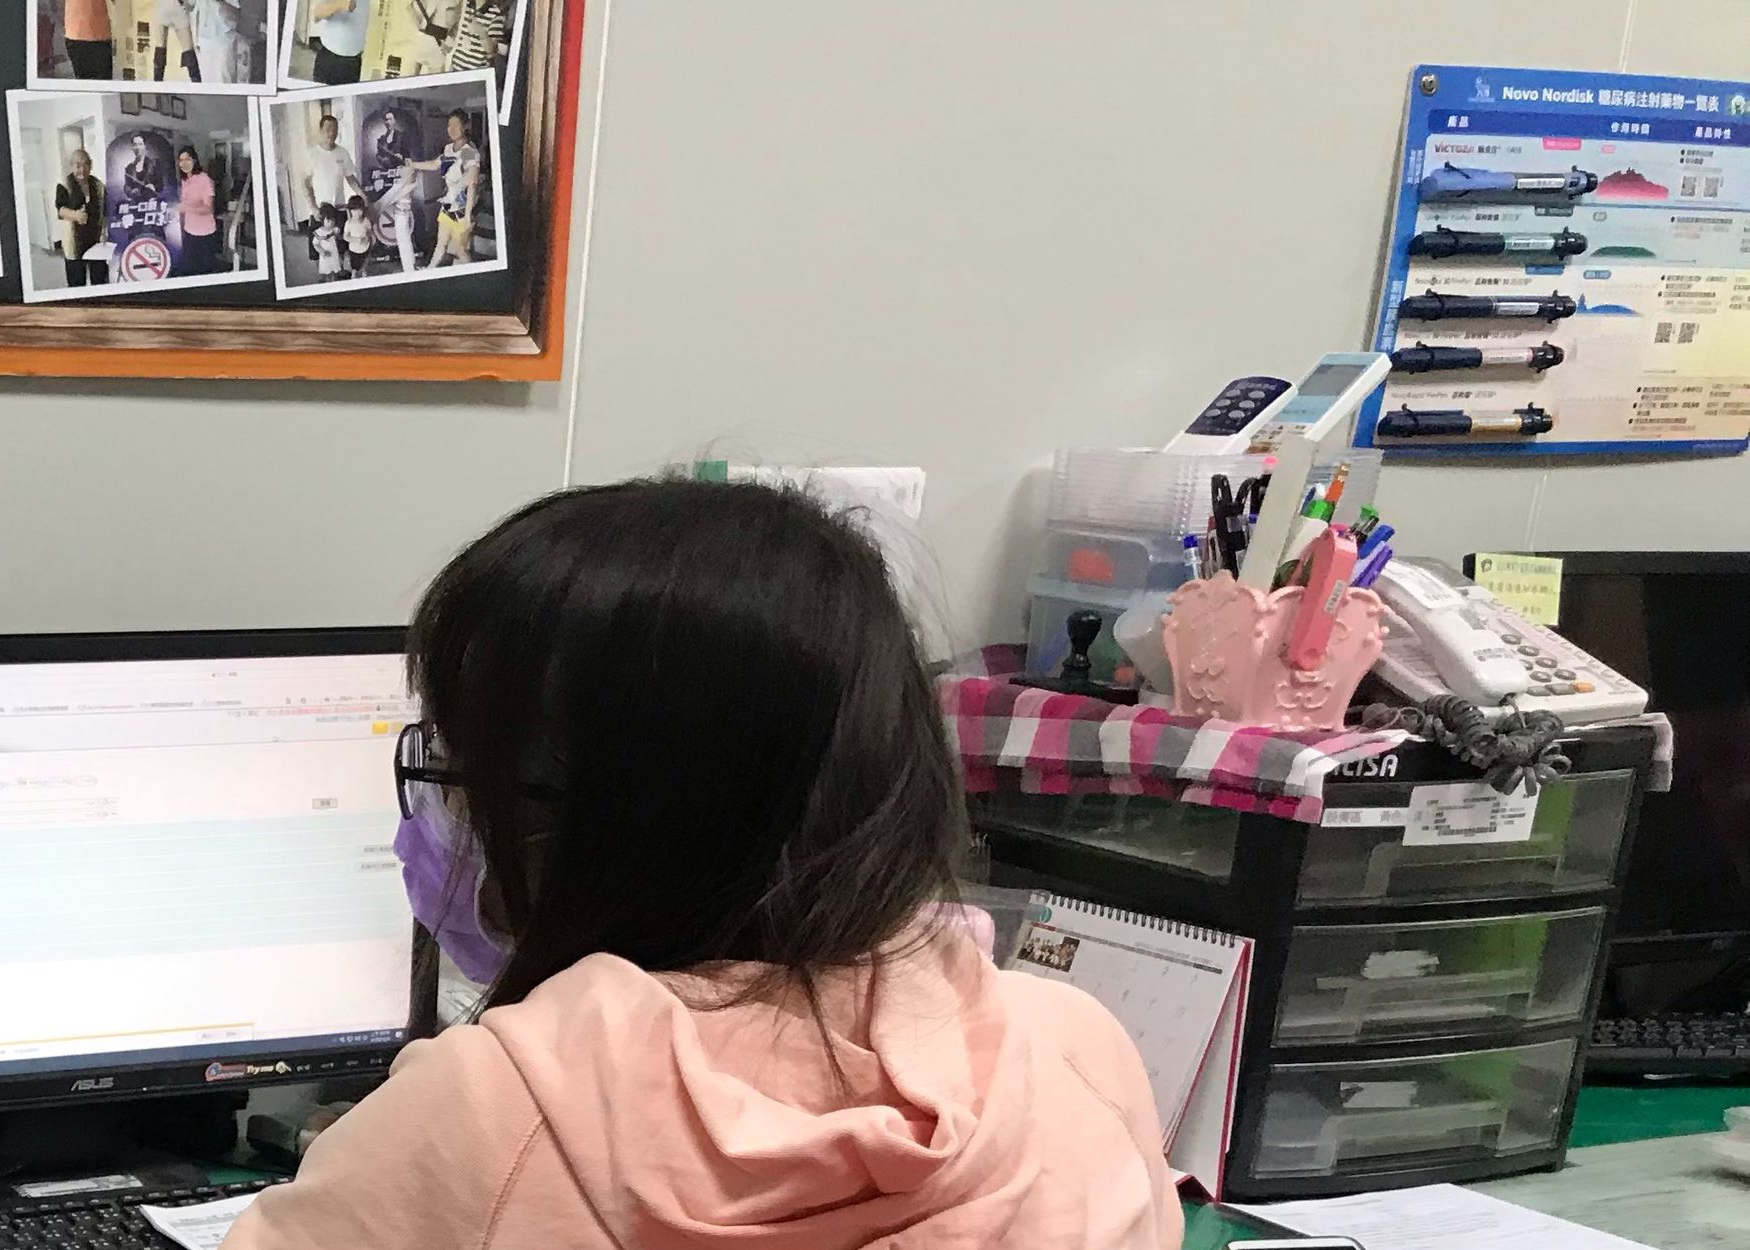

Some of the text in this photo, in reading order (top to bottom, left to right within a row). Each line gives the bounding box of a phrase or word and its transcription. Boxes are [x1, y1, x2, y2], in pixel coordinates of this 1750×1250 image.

[1503, 86, 1539, 101] Novo
[1542, 87, 1595, 104] Nordisk
[71, 1077, 114, 1091] ASUS
